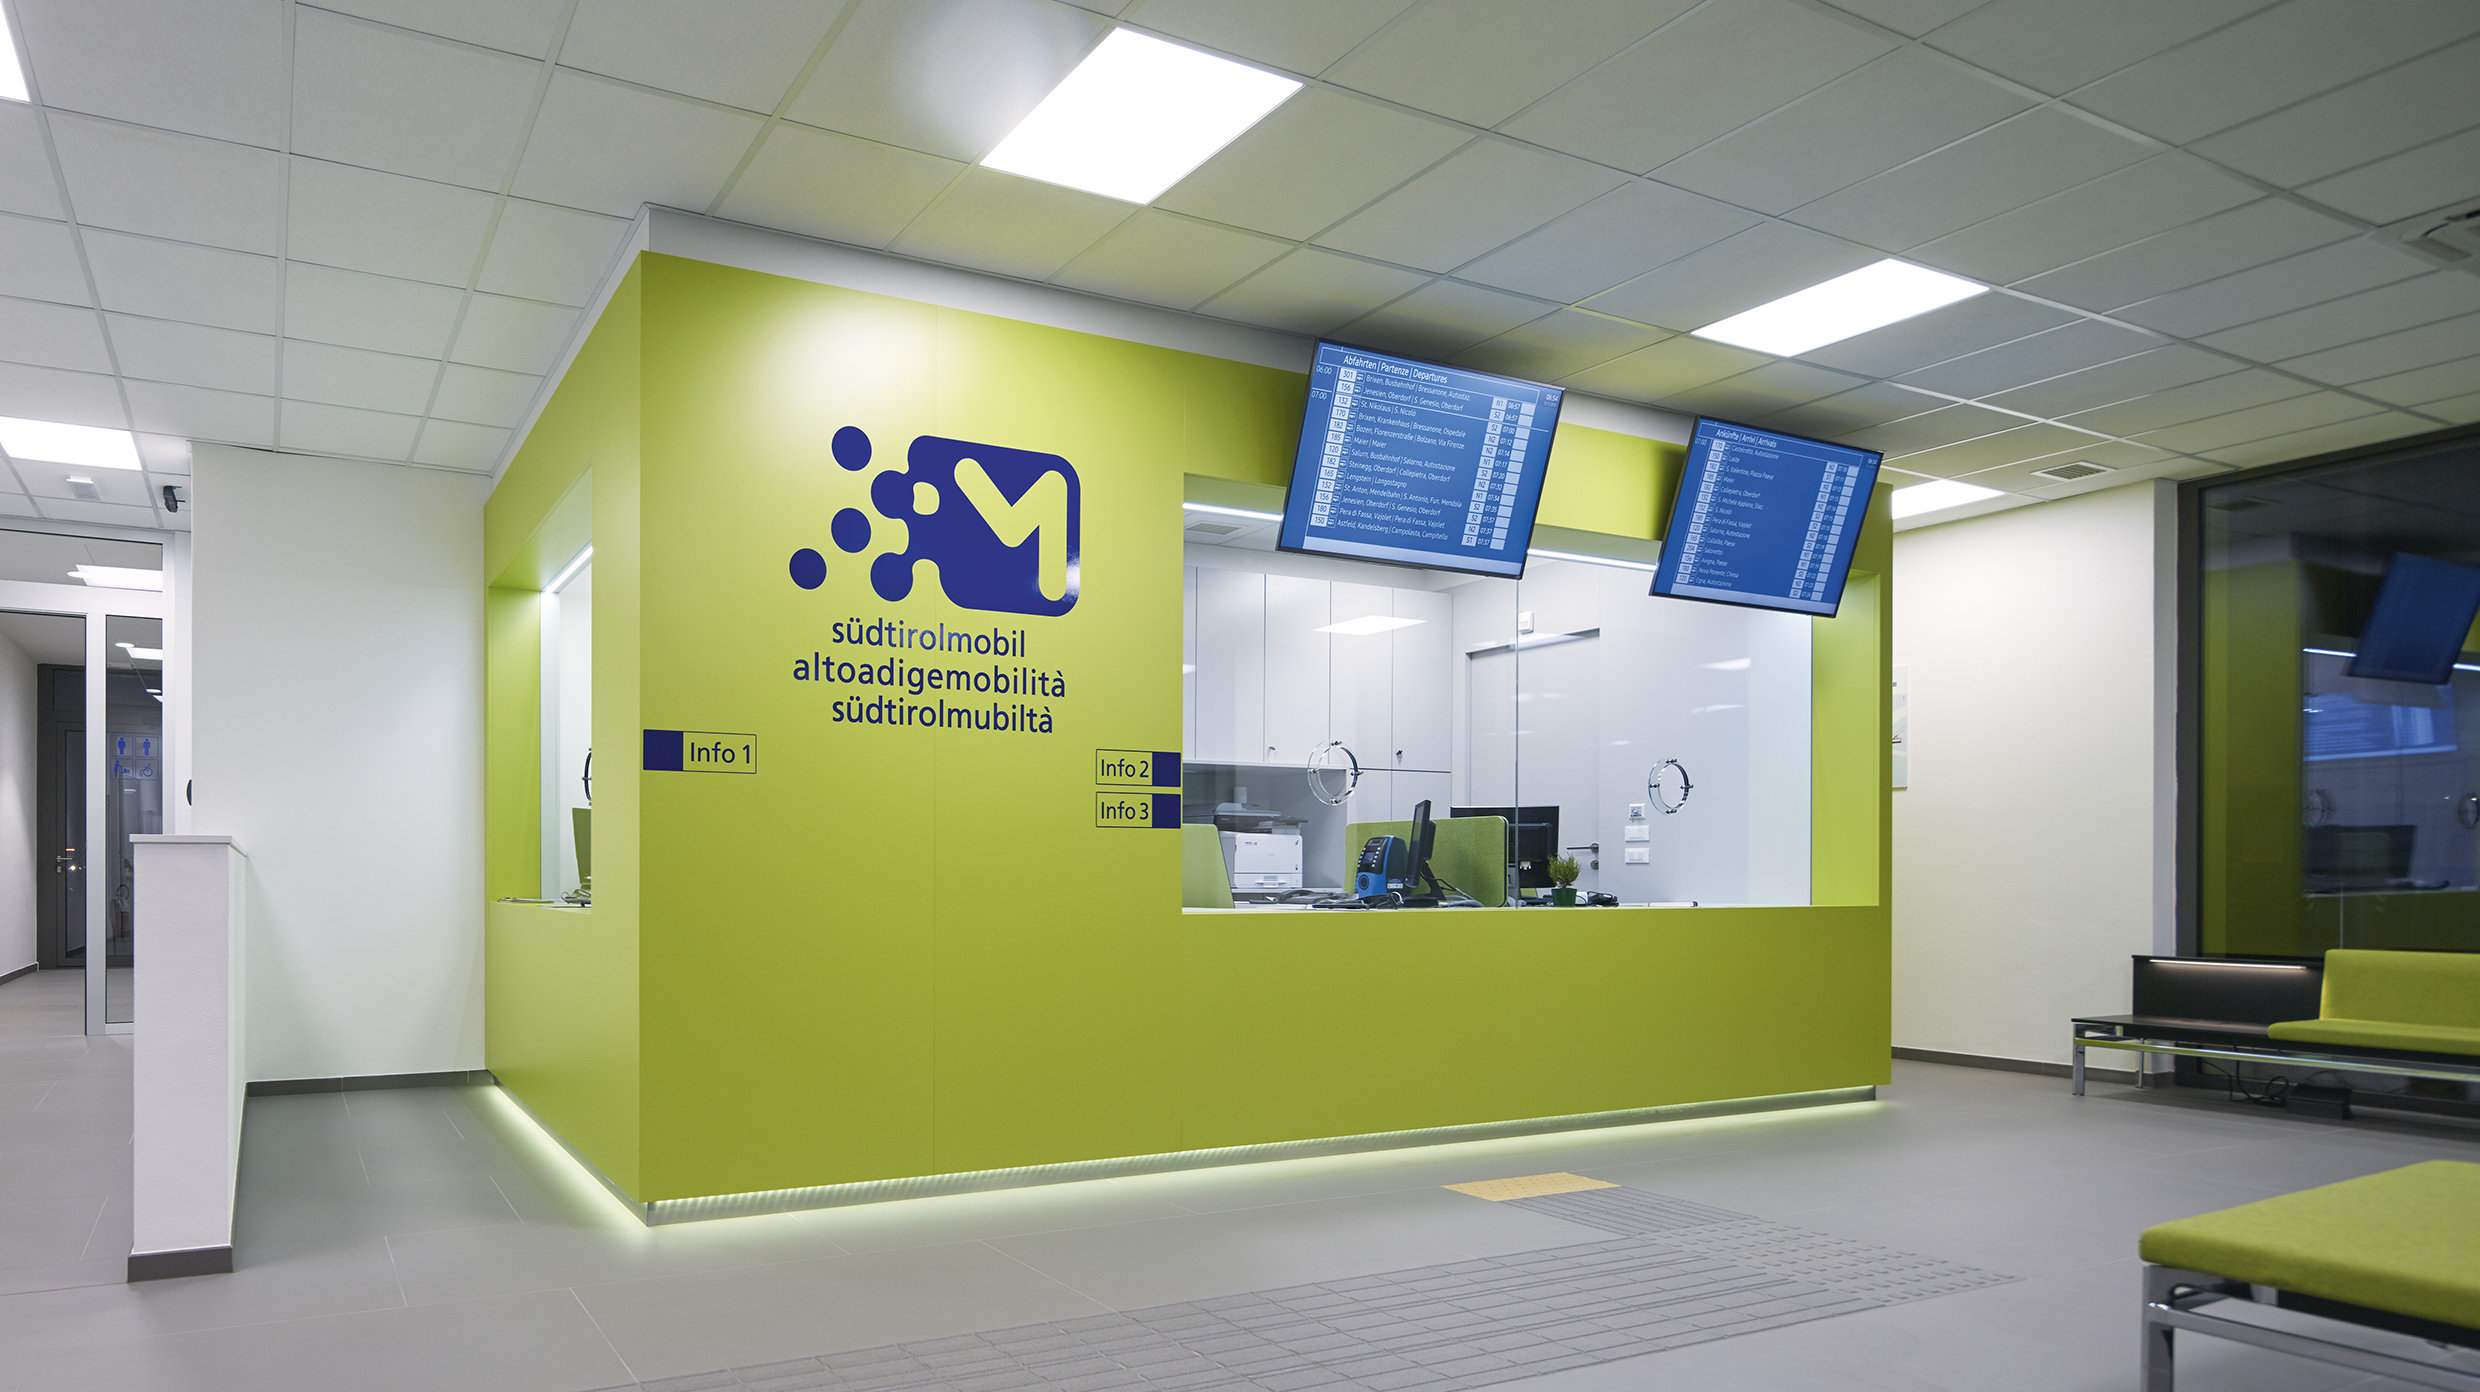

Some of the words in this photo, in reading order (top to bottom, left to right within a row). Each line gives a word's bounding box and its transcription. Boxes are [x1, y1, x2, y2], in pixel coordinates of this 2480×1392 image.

[1316, 366, 1332, 375] 06:00
[1344, 356, 1377, 370] Abfahrten
[1381, 363, 1410, 376] Partenze
[1413, 370, 1448, 385] Departures
[1311, 391, 1327, 400] 07:00
[1343, 371, 1354, 379] 301
[1366, 375, 1384, 386] Brixen,
[1385, 379, 1416, 391] Busbahnhof
[1418, 385, 1448, 398] Bressanone,
[1338, 397, 1349, 405] 132
[1369, 403, 1391, 413] Nikolaus
[1341, 383, 1351, 391] 156
[1363, 388, 1388, 399] Jenesien,
[1388, 392, 1411, 402] Oberdorf
[1419, 398, 1441, 409] Genesio,
[1441, 402, 1464, 412] Oberdorf
[1545, 394, 1559, 402] 06:54
[1333, 421, 1344, 429] 182
[1356, 425, 1374, 436] Bozen,
[1416, 436, 1438, 446] Bolzano,
[1447, 441, 1465, 450] Firenze
[1335, 409, 1346, 417] 170
[1358, 413, 1377, 424] Brixen,
[1377, 417, 1410, 428] Krankenhaus
[1413, 423, 1443, 435] Bressanone,
[1443, 428, 1466, 439] Ospedale
[1354, 437, 1369, 446] Maier
[1372, 440, 1387, 449] Maier
[1716, 430, 1739, 440] Ankünfte
[1742, 435, 1756, 443] Arrivi
[1758, 438, 1777, 448] Arrivals
[1349, 461, 1373, 472] Steinegg,
[1374, 465, 1396, 475] Oberdorf
[1428, 474, 1450, 483] Oberdorf
[1351, 449, 1370, 460] Salurn,
[1370, 452, 1401, 463] Busbahnhof
[1403, 458, 1424, 468] Salorno,
[1424, 461, 1456, 472] Autostazione
[1346, 473, 1372, 484] Lengstein
[1374, 477, 1407, 490] Longostagno
[1319, 493, 1329, 501] 156
[1342, 497, 1365, 507] Jenesien,
[1366, 500, 1389, 509] Oberdorf
[1397, 504, 1418, 515] Genesio,
[1418, 507, 1441, 516] Oberdorf
[1321, 481, 1332, 489] 132
[1353, 486, 1369, 496] Anton,
[1409, 494, 1430, 505] Antonio,
[1441, 499, 1462, 508] Mendola
[1317, 505, 1327, 513] 180
[1340, 508, 1351, 516] Pera
[1357, 511, 1374, 520] Fassa,
[1412, 518, 1428, 528] Fassa,
[1337, 520, 1357, 530] Astfeld,
[1421, 531, 1449, 542] Campitello
[831, 617, 1026, 658] südtirolmobil
[793, 652, 1066, 698] altoadigemobilità
[831, 695, 1054, 734] südtirolmubiltà
[690, 741, 736, 764] Info
[742, 744, 751, 764] 1
[1100, 758, 1136, 779] Info
[1138, 760, 1150, 778] 2
[1100, 801, 1136, 821] Info
[1138, 802, 1150, 820] 3
